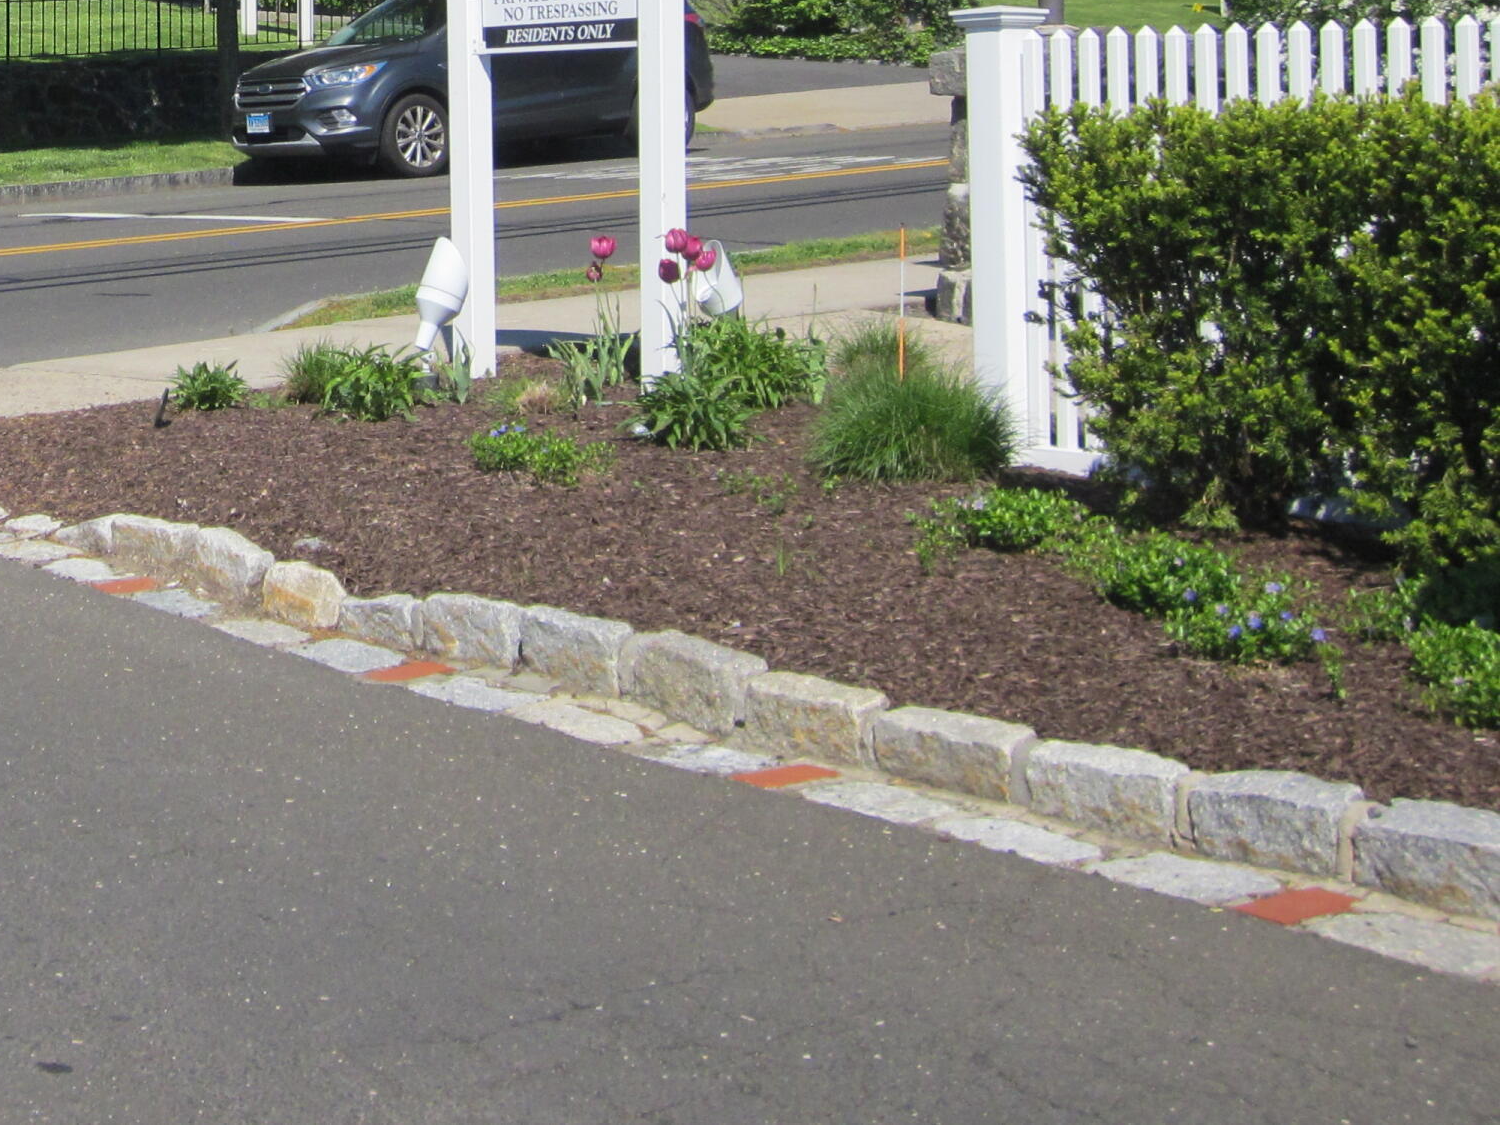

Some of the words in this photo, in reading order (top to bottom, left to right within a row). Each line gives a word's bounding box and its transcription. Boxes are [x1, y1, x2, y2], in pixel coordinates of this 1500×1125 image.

[503, 6, 524, 22] NO
[528, 1, 618, 21] TRESPASSING
[505, 26, 575, 44] RESIDENTS
[577, 23, 615, 39] ONLY
